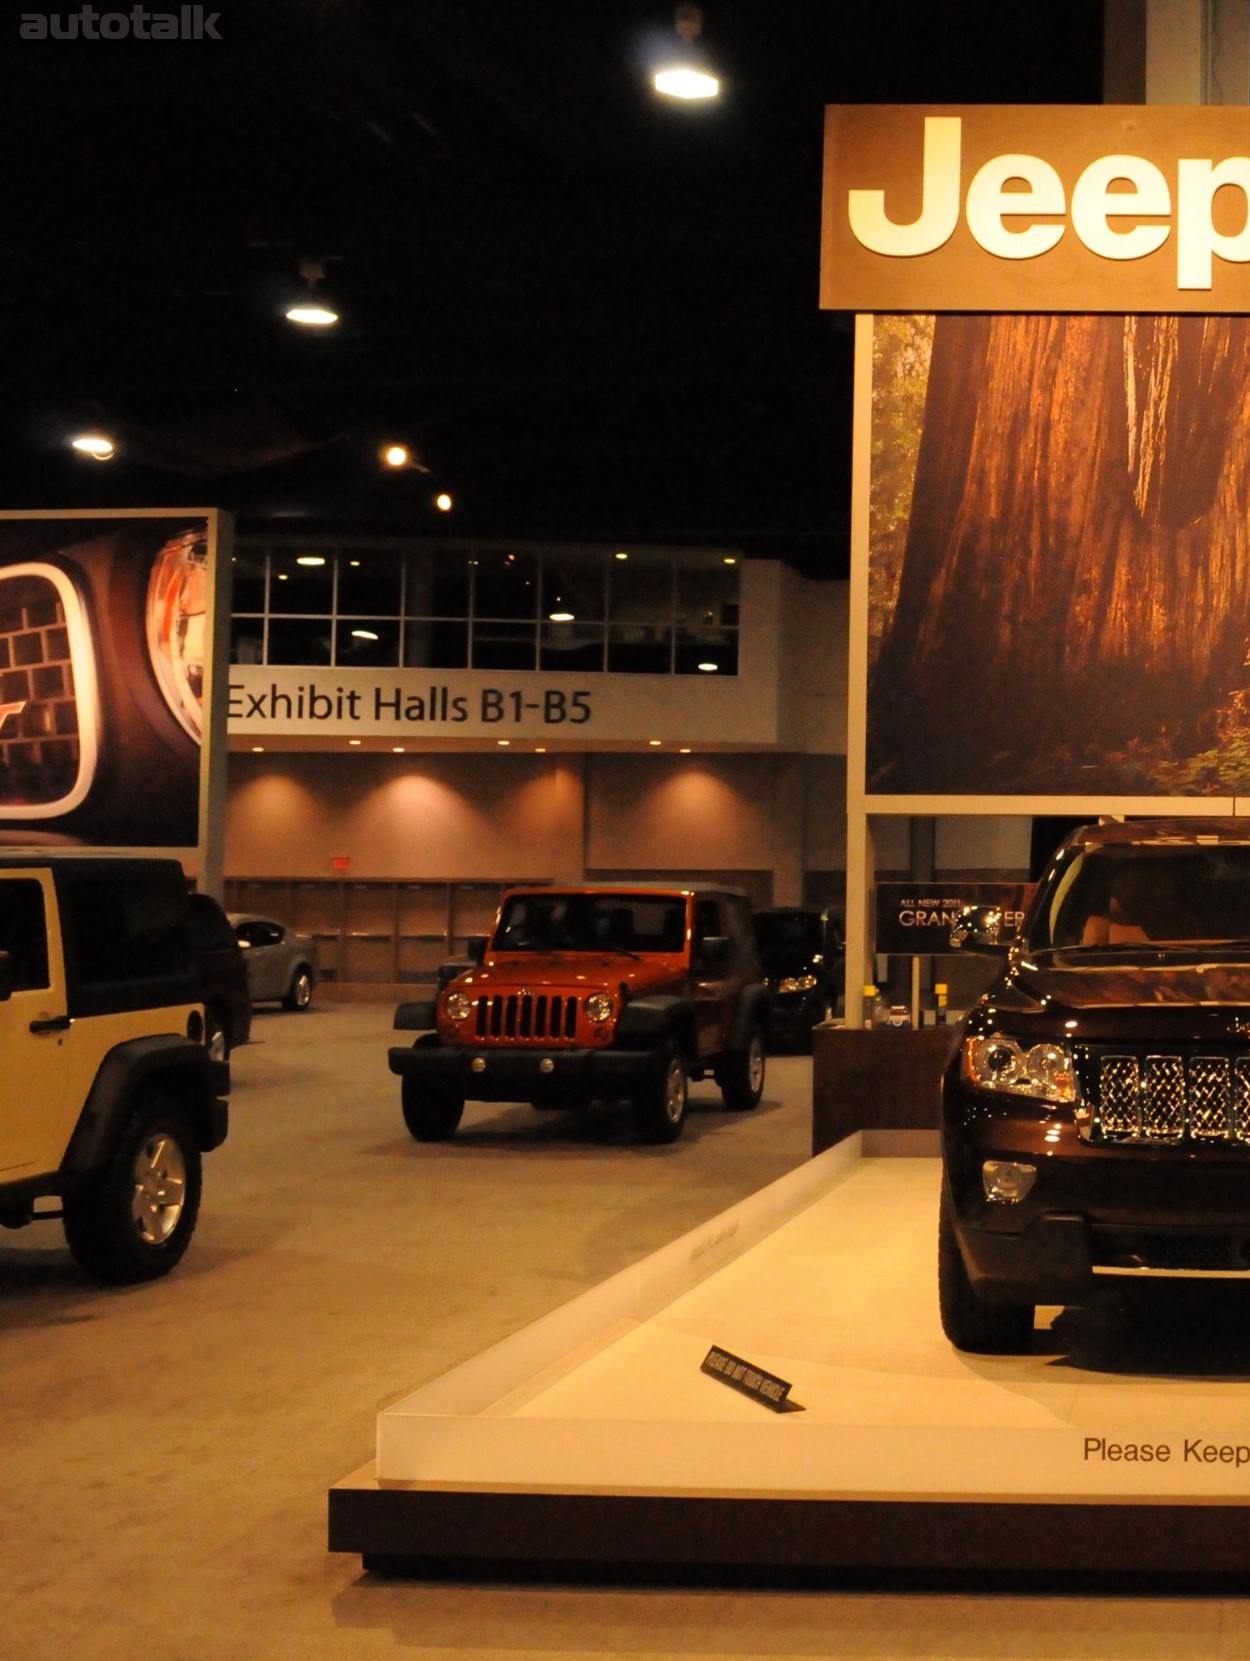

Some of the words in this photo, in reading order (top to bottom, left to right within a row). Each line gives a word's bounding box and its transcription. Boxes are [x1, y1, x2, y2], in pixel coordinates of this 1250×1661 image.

[228, 683, 361, 721] Exhibit
[374, 686, 469, 722] Halls
[481, 688, 592, 724] B1-B5
[900, 899, 916, 908] ALL
[918, 899, 941, 908] NEW
[899, 910, 957, 926] GRAN
[1084, 1437, 1171, 1462] Please
[1183, 1439, 1250, 1468] Keep
